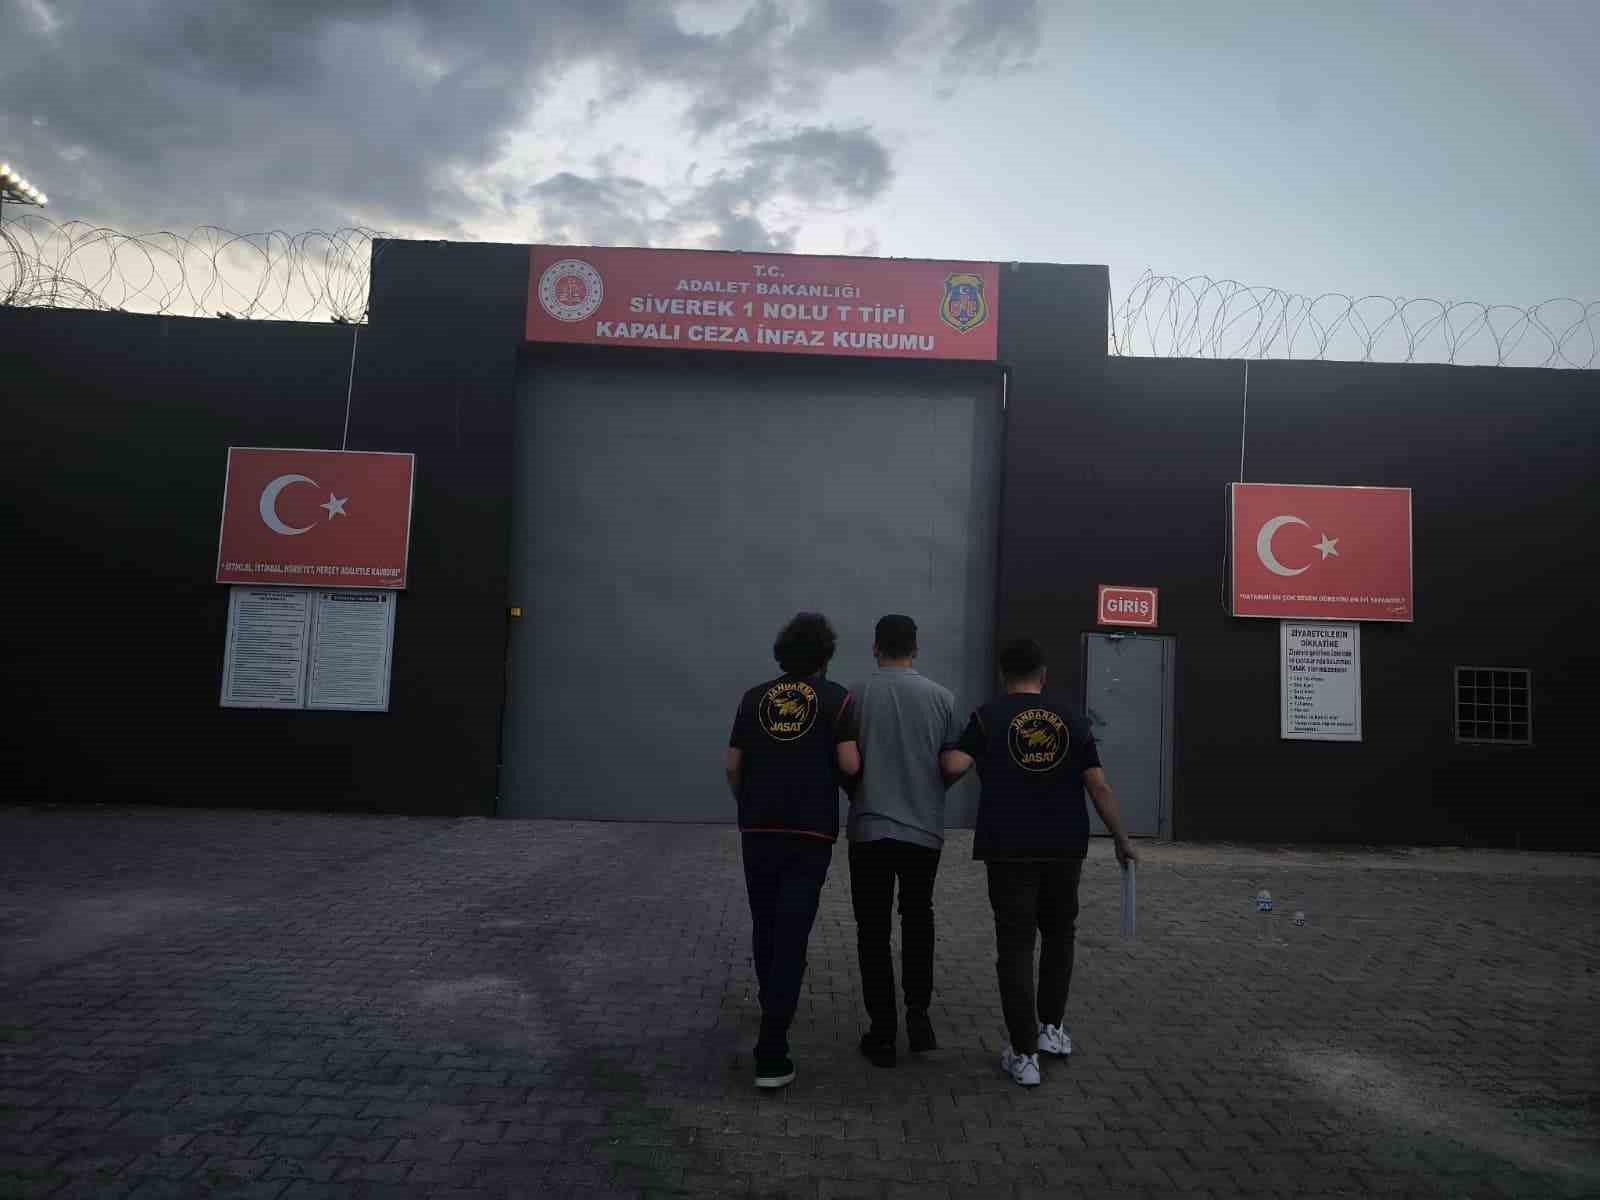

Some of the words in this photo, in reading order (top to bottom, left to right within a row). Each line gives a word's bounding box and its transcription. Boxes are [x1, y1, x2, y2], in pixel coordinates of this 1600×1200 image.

[753, 264, 785, 278] T.C.
[676, 279, 751, 294] ADALET
[756, 281, 861, 298] BAKANLIĞI
[629, 294, 735, 317] SİVEREK
[743, 302, 753, 318] 1
[763, 303, 828, 321] NOLU
[836, 305, 851, 322] T
[858, 303, 905, 325] TİPİ
[596, 321, 681, 341] KAPALI
[688, 325, 750, 344] CEZA
[757, 324, 826, 347] İNFAZ
[832, 331, 936, 351] KURUMU
[1107, 597, 1149, 617] GİRİŞ
[769, 722, 804, 733] JASAT
[1023, 752, 1057, 763] JASAT
